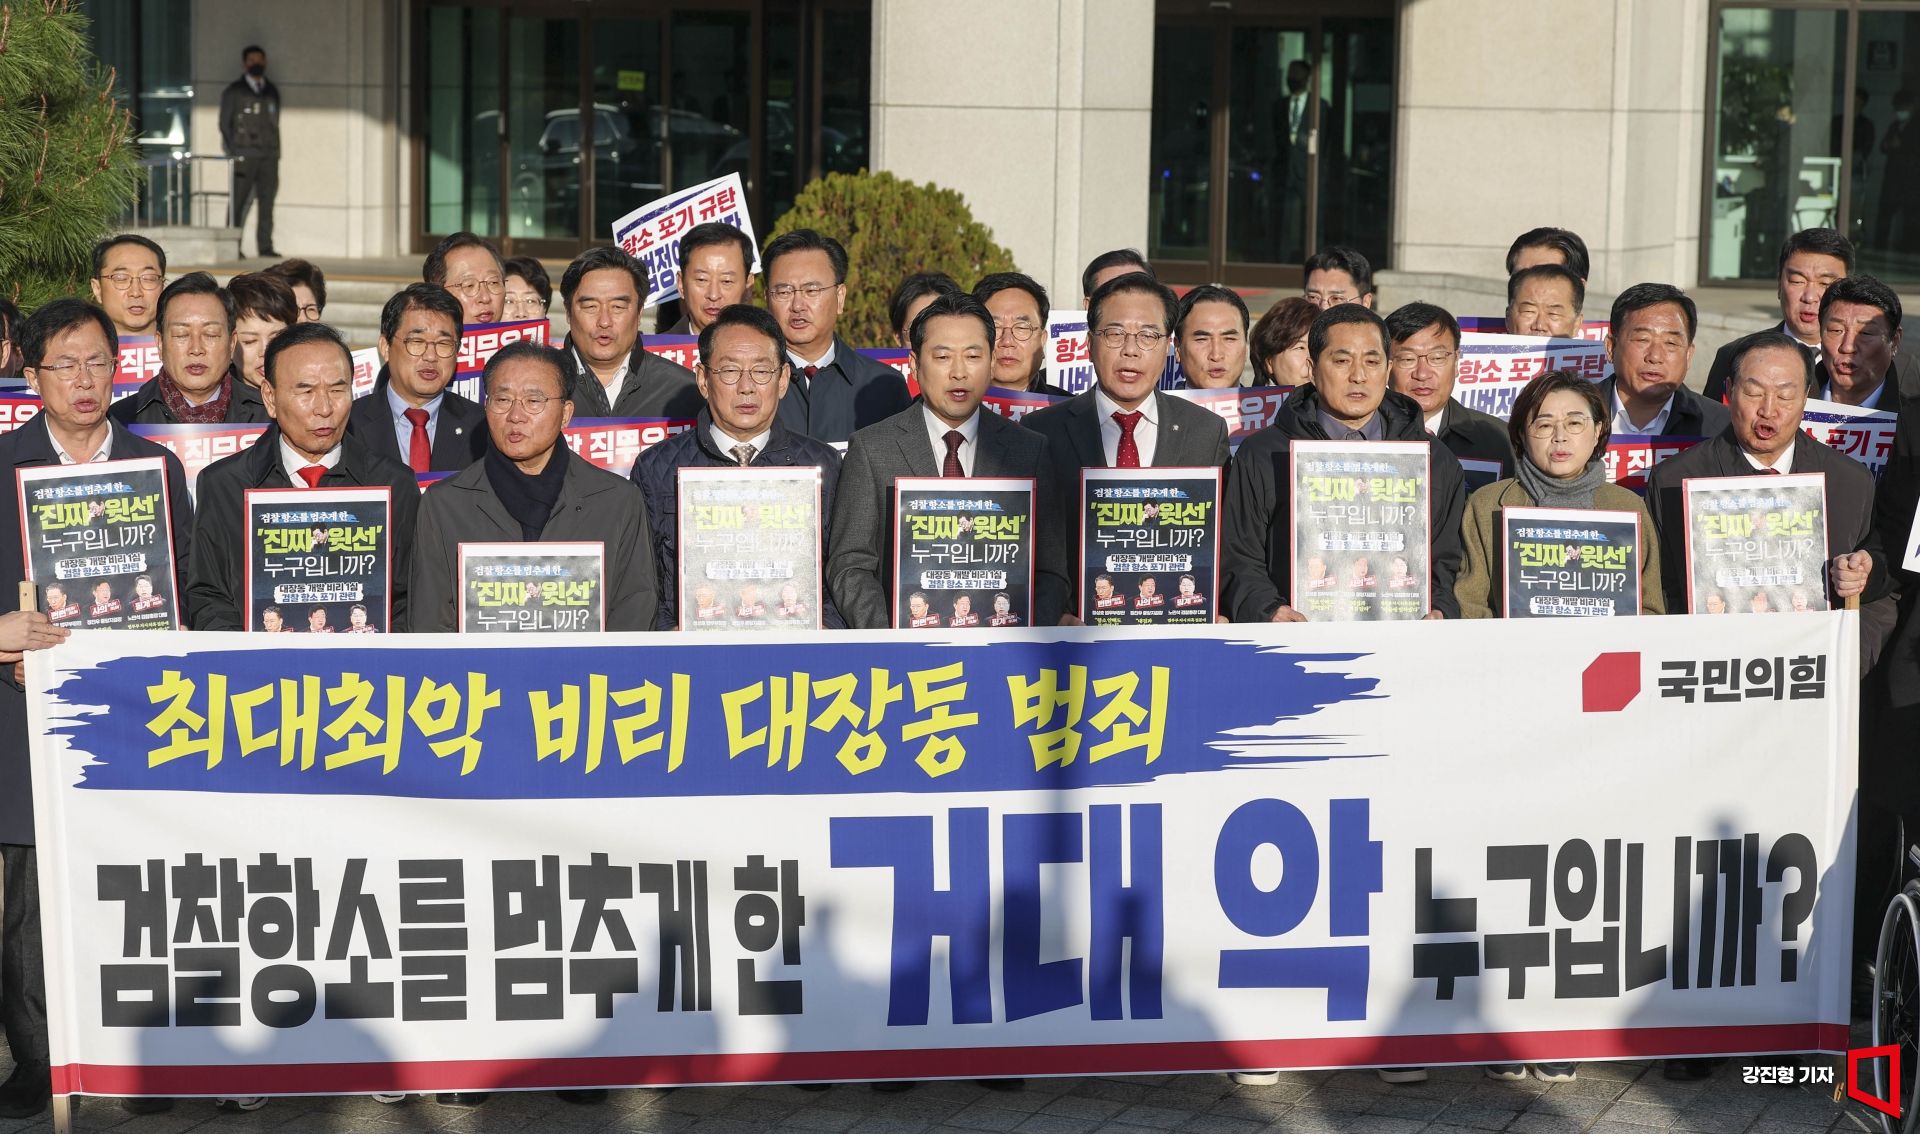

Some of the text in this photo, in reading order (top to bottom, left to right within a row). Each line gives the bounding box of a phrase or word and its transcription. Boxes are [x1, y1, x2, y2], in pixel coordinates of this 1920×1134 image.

[622, 186, 737, 257] 항소 포기 규탄
[1459, 354, 1608, 384] 항소 포기 규탄
[1876, 431, 1896, 458] 규
[34, 481, 124, 500] 검찰 항소를 멈추게 한
[1094, 487, 1179, 498] 검찰 항소를 멈추게 한
[32, 494, 159, 530] '진짜 윗선'
[909, 500, 994, 511] 검찰 항소를 멈추게 한
[1090, 501, 1212, 526] '진짜 윗선'
[1309, 505, 1416, 526] 누구입니까?
[260, 511, 349, 523] 검찰 항소를 멈추게 한
[906, 514, 1026, 540] '진짜 윗선'
[42, 524, 156, 554] 누구입니까?
[257, 525, 383, 554] '진짜 윗선'
[1096, 528, 1205, 549] 누구입니까?
[1516, 528, 1600, 540] 검찰 항소를 멈추게 한
[60, 552, 141, 569] 대장동 개발 비리 1심
[911, 543, 1019, 564] 누구입니까?
[1111, 554, 1187, 563] 대장동 개발 비리 1심
[1513, 542, 1632, 570] '진짜 윗선'
[63, 562, 140, 579] 검찰 항소 포기 관련
[263, 554, 376, 578] 누구입니까?
[926, 570, 1002, 580] 대장동 개발 비리 1심
[1113, 562, 1186, 572] 검찰 항소 포기 관련
[280, 582, 358, 593] 대장동 개발 비리 1심
[928, 579, 1001, 589] 검찰 항소 포기 관련
[1520, 570, 1626, 592] 누구입니까?
[282, 591, 357, 603] 검찰 항소 포기 관련
[470, 580, 596, 607] '진짜 윗선'
[1535, 597, 1560, 606] 대장동
[1580, 598, 1596, 606] 비리
[477, 609, 590, 631] 누구입니까?
[1537, 605, 1609, 616] 검찰 항소 포기 관련
[1658, 654, 1827, 704] 국민의힘
[145, 661, 1171, 779] 최대최악 비리 대장동 범죄
[96, 797, 1818, 1029] 검찰항소를 멈추게 한 거대 악 누구입니까?
